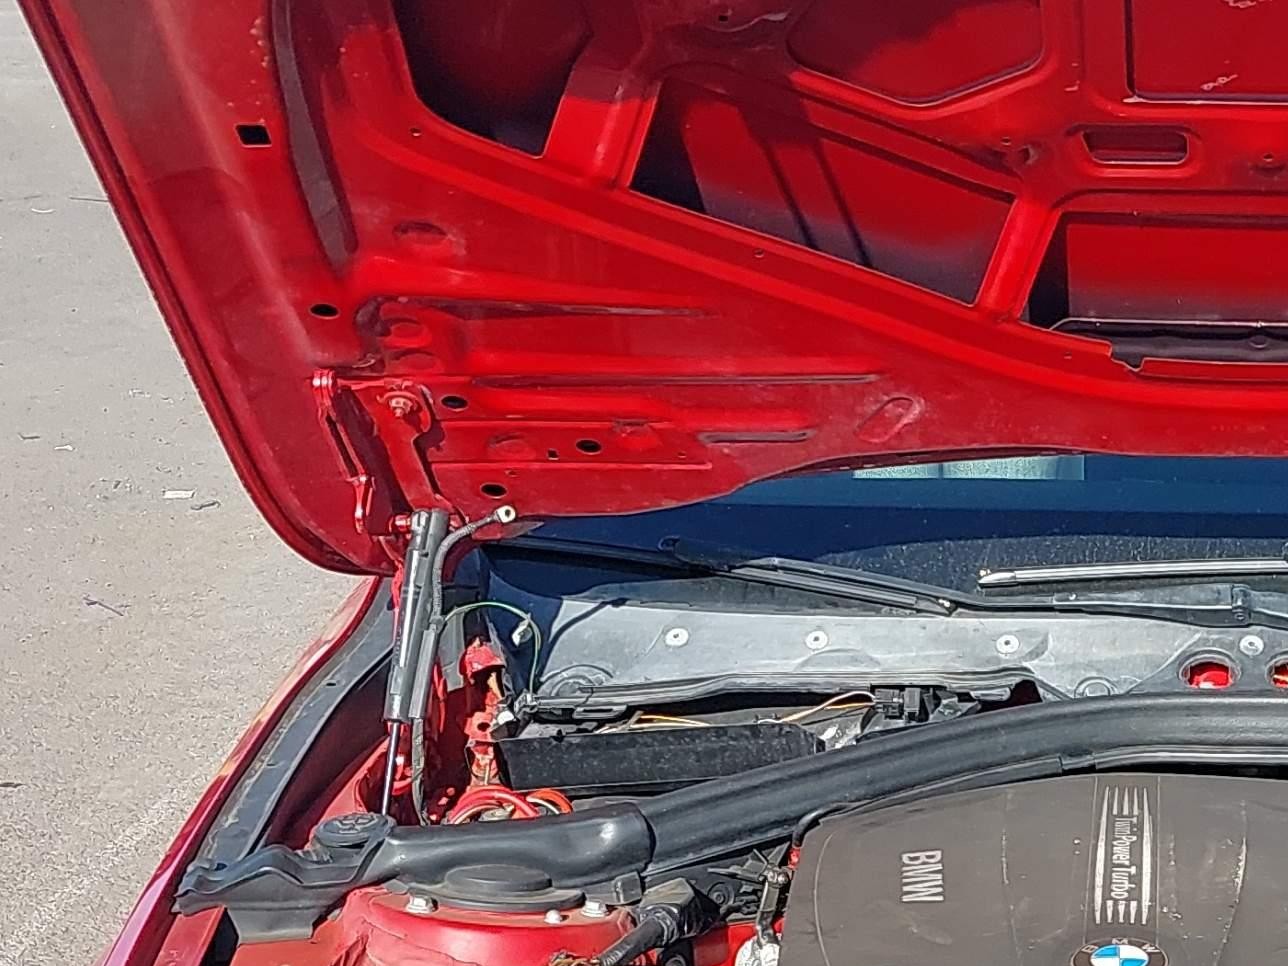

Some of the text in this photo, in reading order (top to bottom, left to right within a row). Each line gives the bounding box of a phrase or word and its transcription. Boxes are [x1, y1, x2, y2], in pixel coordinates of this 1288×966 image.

[902, 849, 944, 902] BMW
[1110, 817, 1137, 900] TwinPower Turbo
[1081, 937, 1161, 953] BMW
